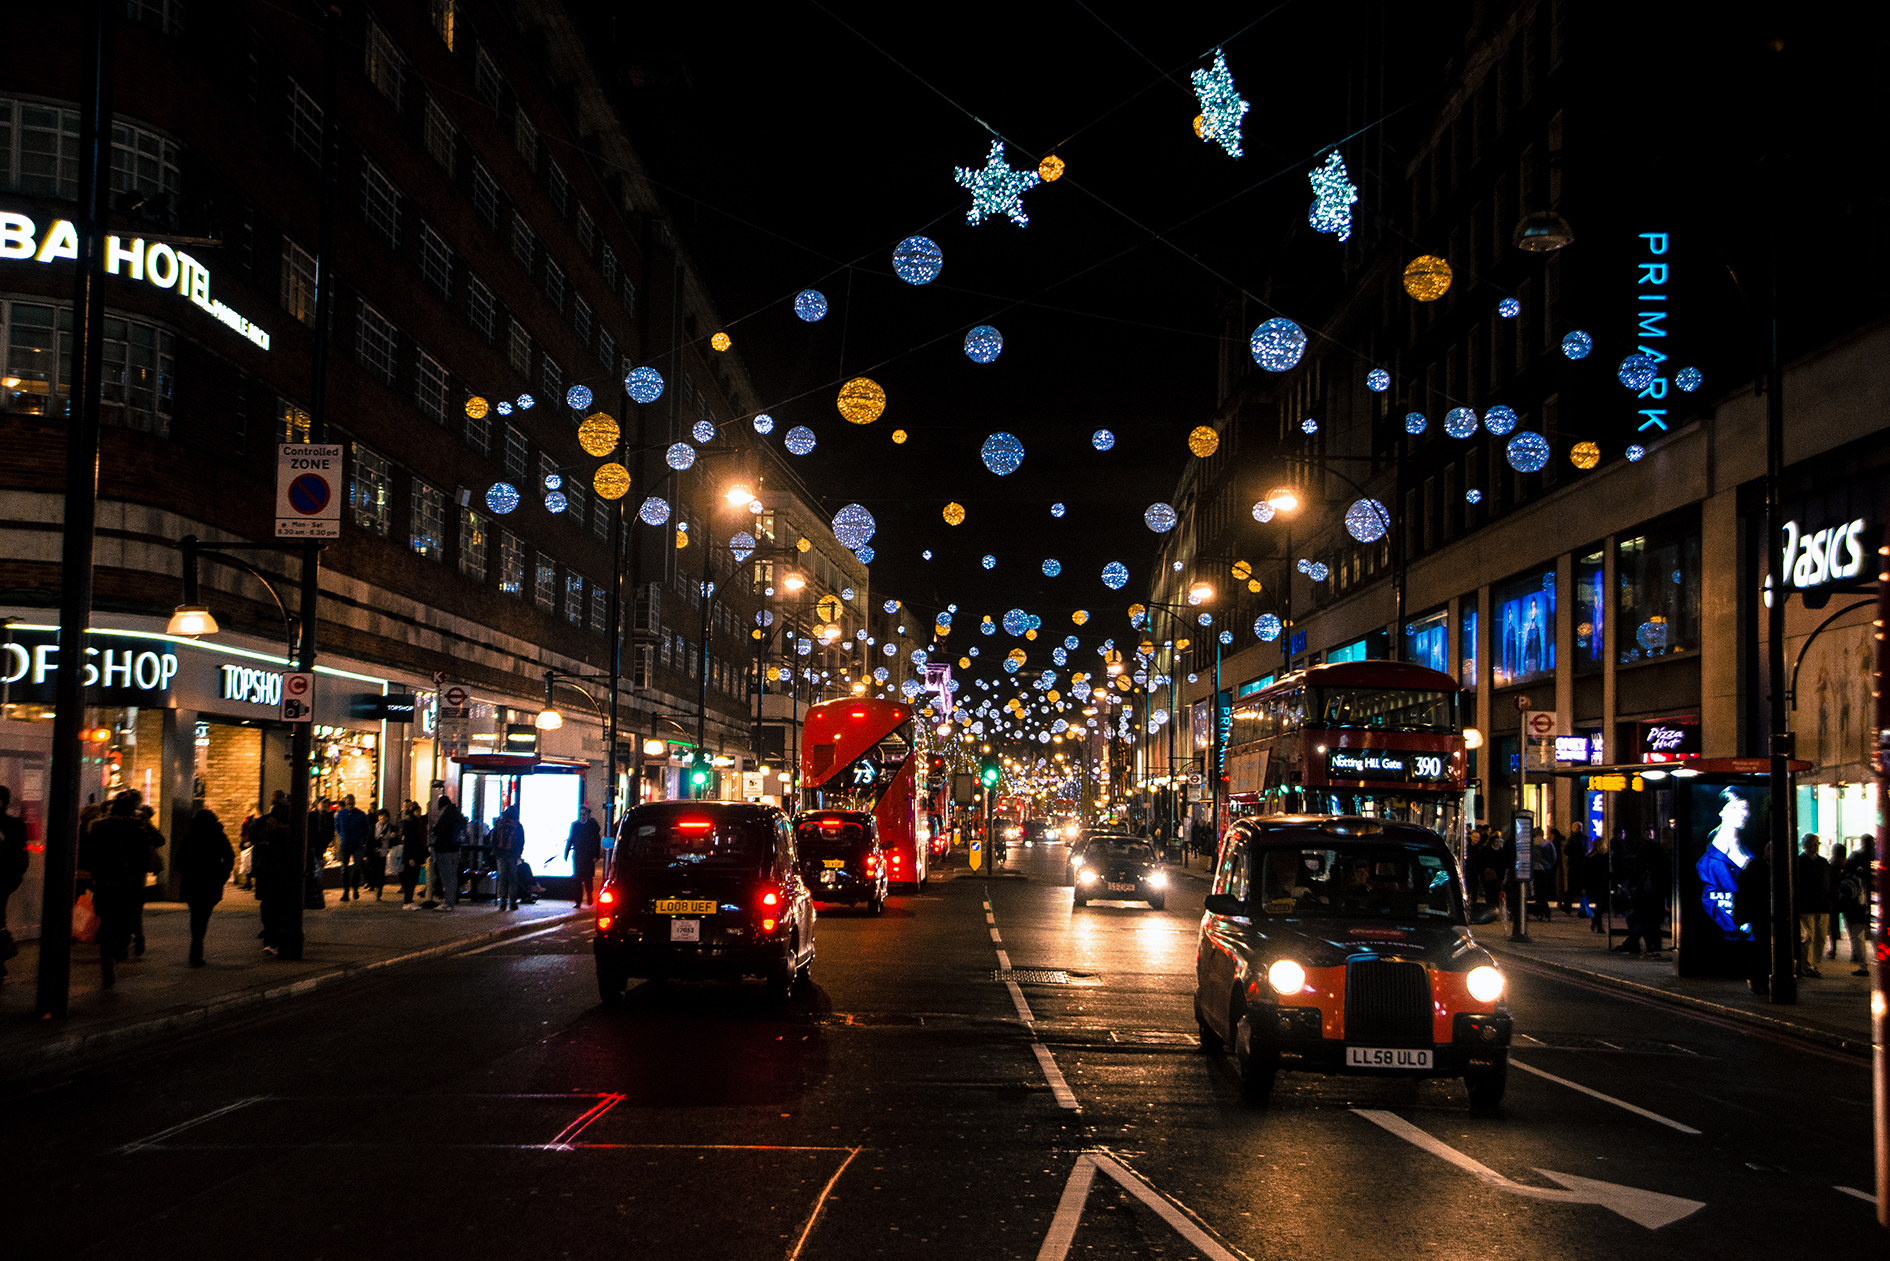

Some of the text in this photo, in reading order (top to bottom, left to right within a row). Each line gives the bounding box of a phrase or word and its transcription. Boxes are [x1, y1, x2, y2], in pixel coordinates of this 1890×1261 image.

[103, 235, 214, 313] HOTEL
[1638, 232, 1669, 431] PRIMARK
[283, 446, 339, 456] Controlled
[290, 459, 330, 470] ZONE
[433, 671, 443, 682] K
[1518, 696, 1528, 709] P
[1647, 726, 1685, 742] Pizza
[1652, 738, 1682, 751] Hut
[1332, 756, 1441, 777] Notting Hill Gate 390
[853, 768, 873, 784] 73
[660, 902, 712, 911] LO08 UEF
[1352, 1049, 1427, 1066] LL58 ULO
